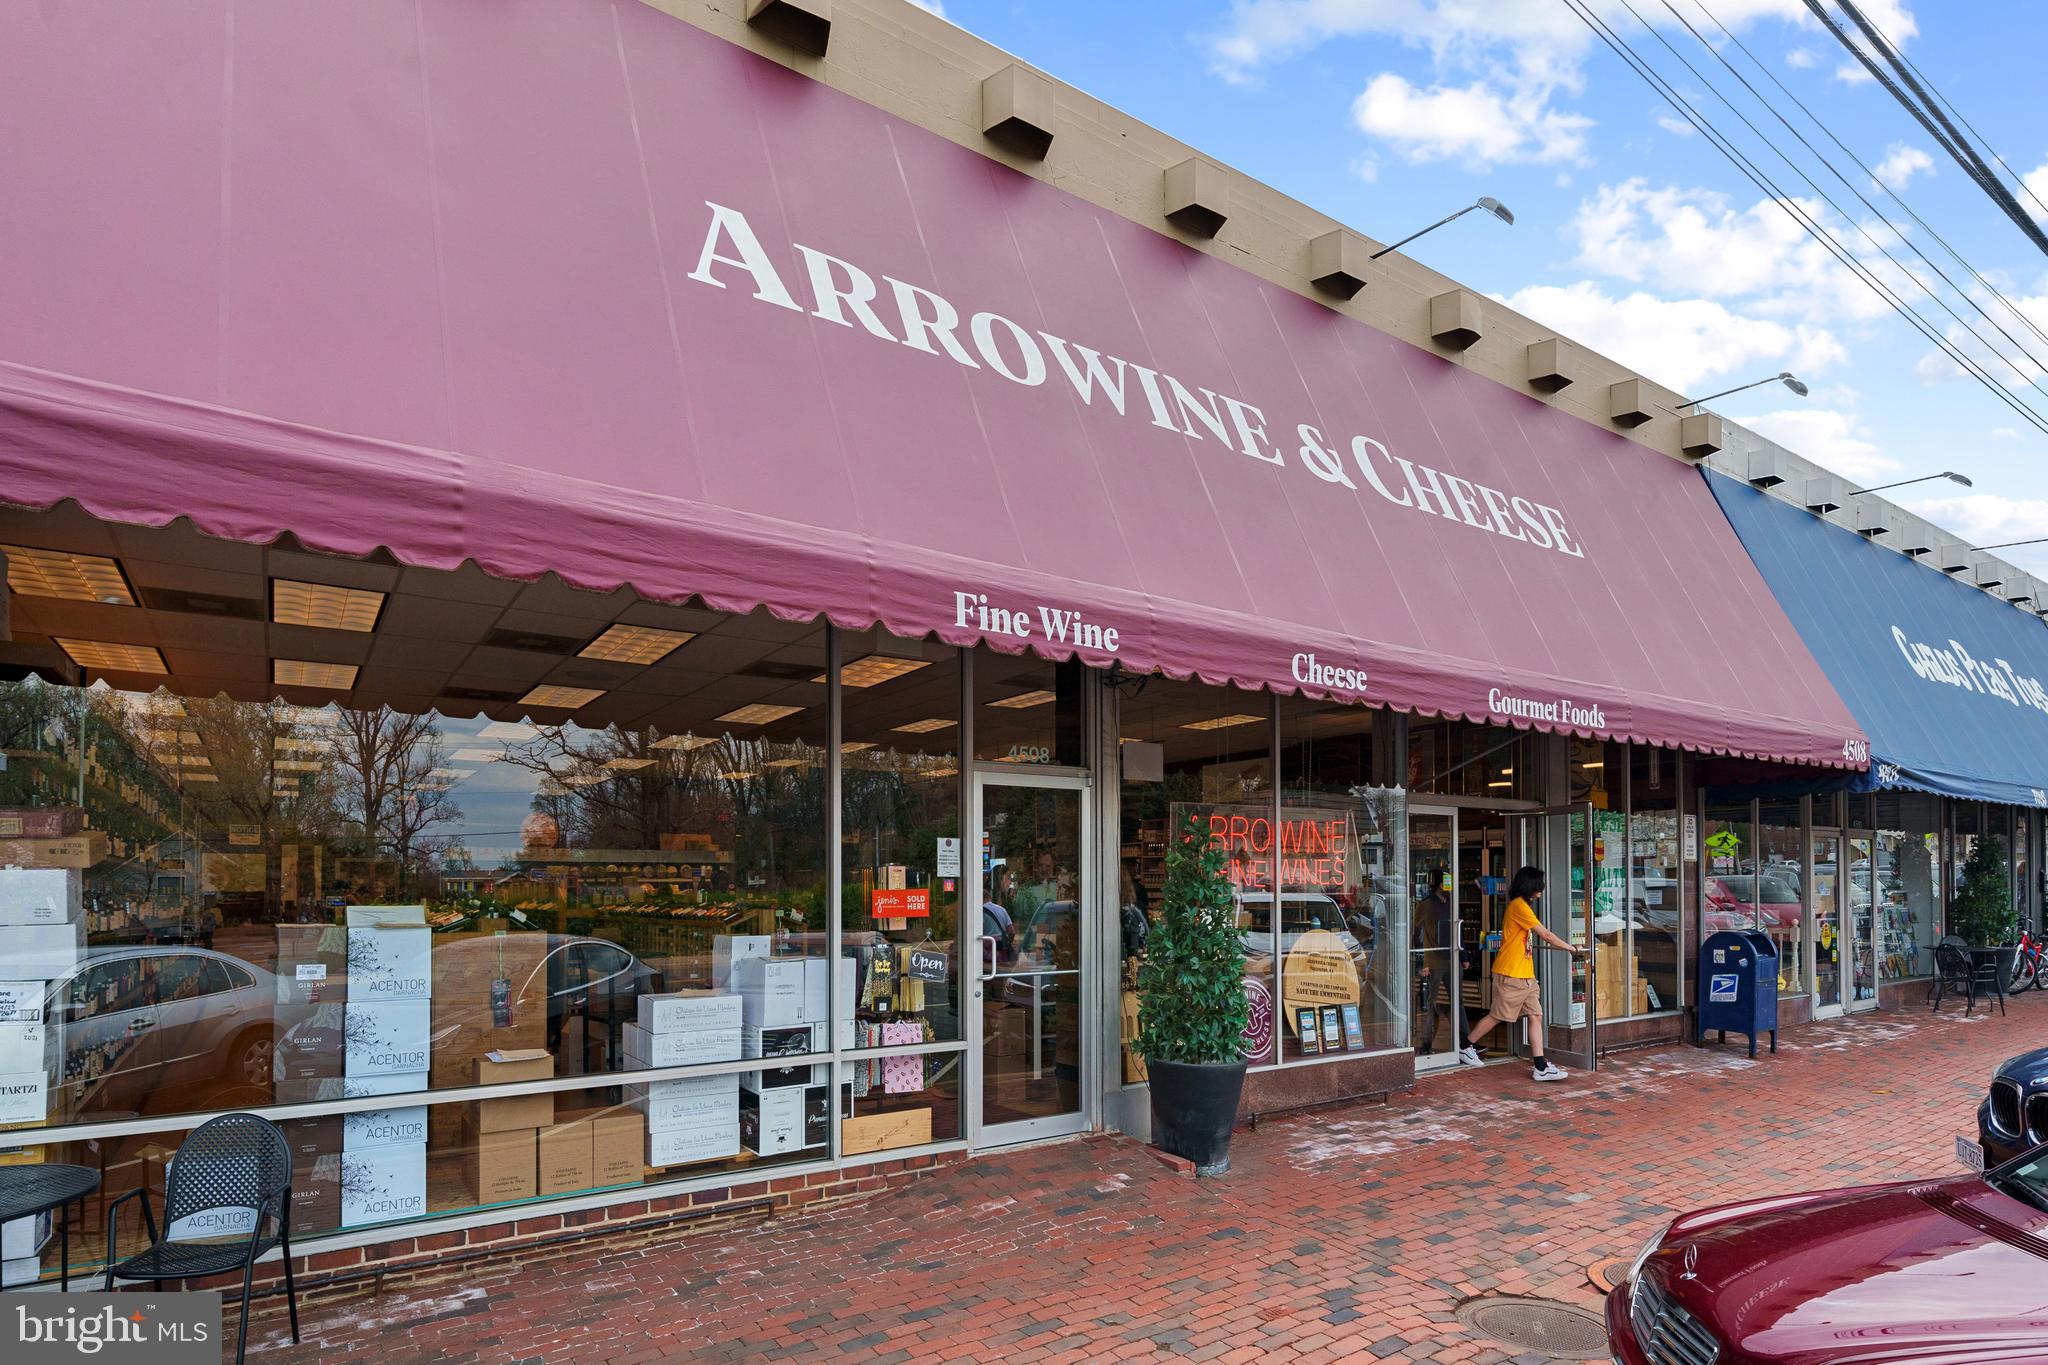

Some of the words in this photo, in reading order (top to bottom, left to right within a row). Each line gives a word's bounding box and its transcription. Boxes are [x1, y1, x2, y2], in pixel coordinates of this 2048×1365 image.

[687, 200, 1285, 467] ARROWINE
[1297, 424, 1357, 490] &
[1351, 435, 1585, 558] CHEESE
[953, 590, 1030, 638] Fine
[1037, 605, 1120, 652] Wine
[1291, 652, 1368, 691] Cheese
[1488, 687, 1558, 722] Gourmet
[1561, 699, 1606, 729] Foods
[1008, 744, 1050, 764] 4508
[1842, 739, 1867, 763] 4508
[1280, 858, 1346, 886] WINES
[906, 895, 926, 903] SOLD
[911, 952, 945, 972] Open
[297, 981, 326, 989] GIRLAN
[369, 978, 426, 992] ACENTOR
[293, 1037, 322, 1045] GIRLAN
[368, 1051, 425, 1066] ACENTOR
[365, 1122, 423, 1140] ACENTOR
[291, 1190, 320, 1199] GIRLAN
[364, 1196, 421, 1215] ACENTOR
[187, 1211, 251, 1229] ACENTOR
